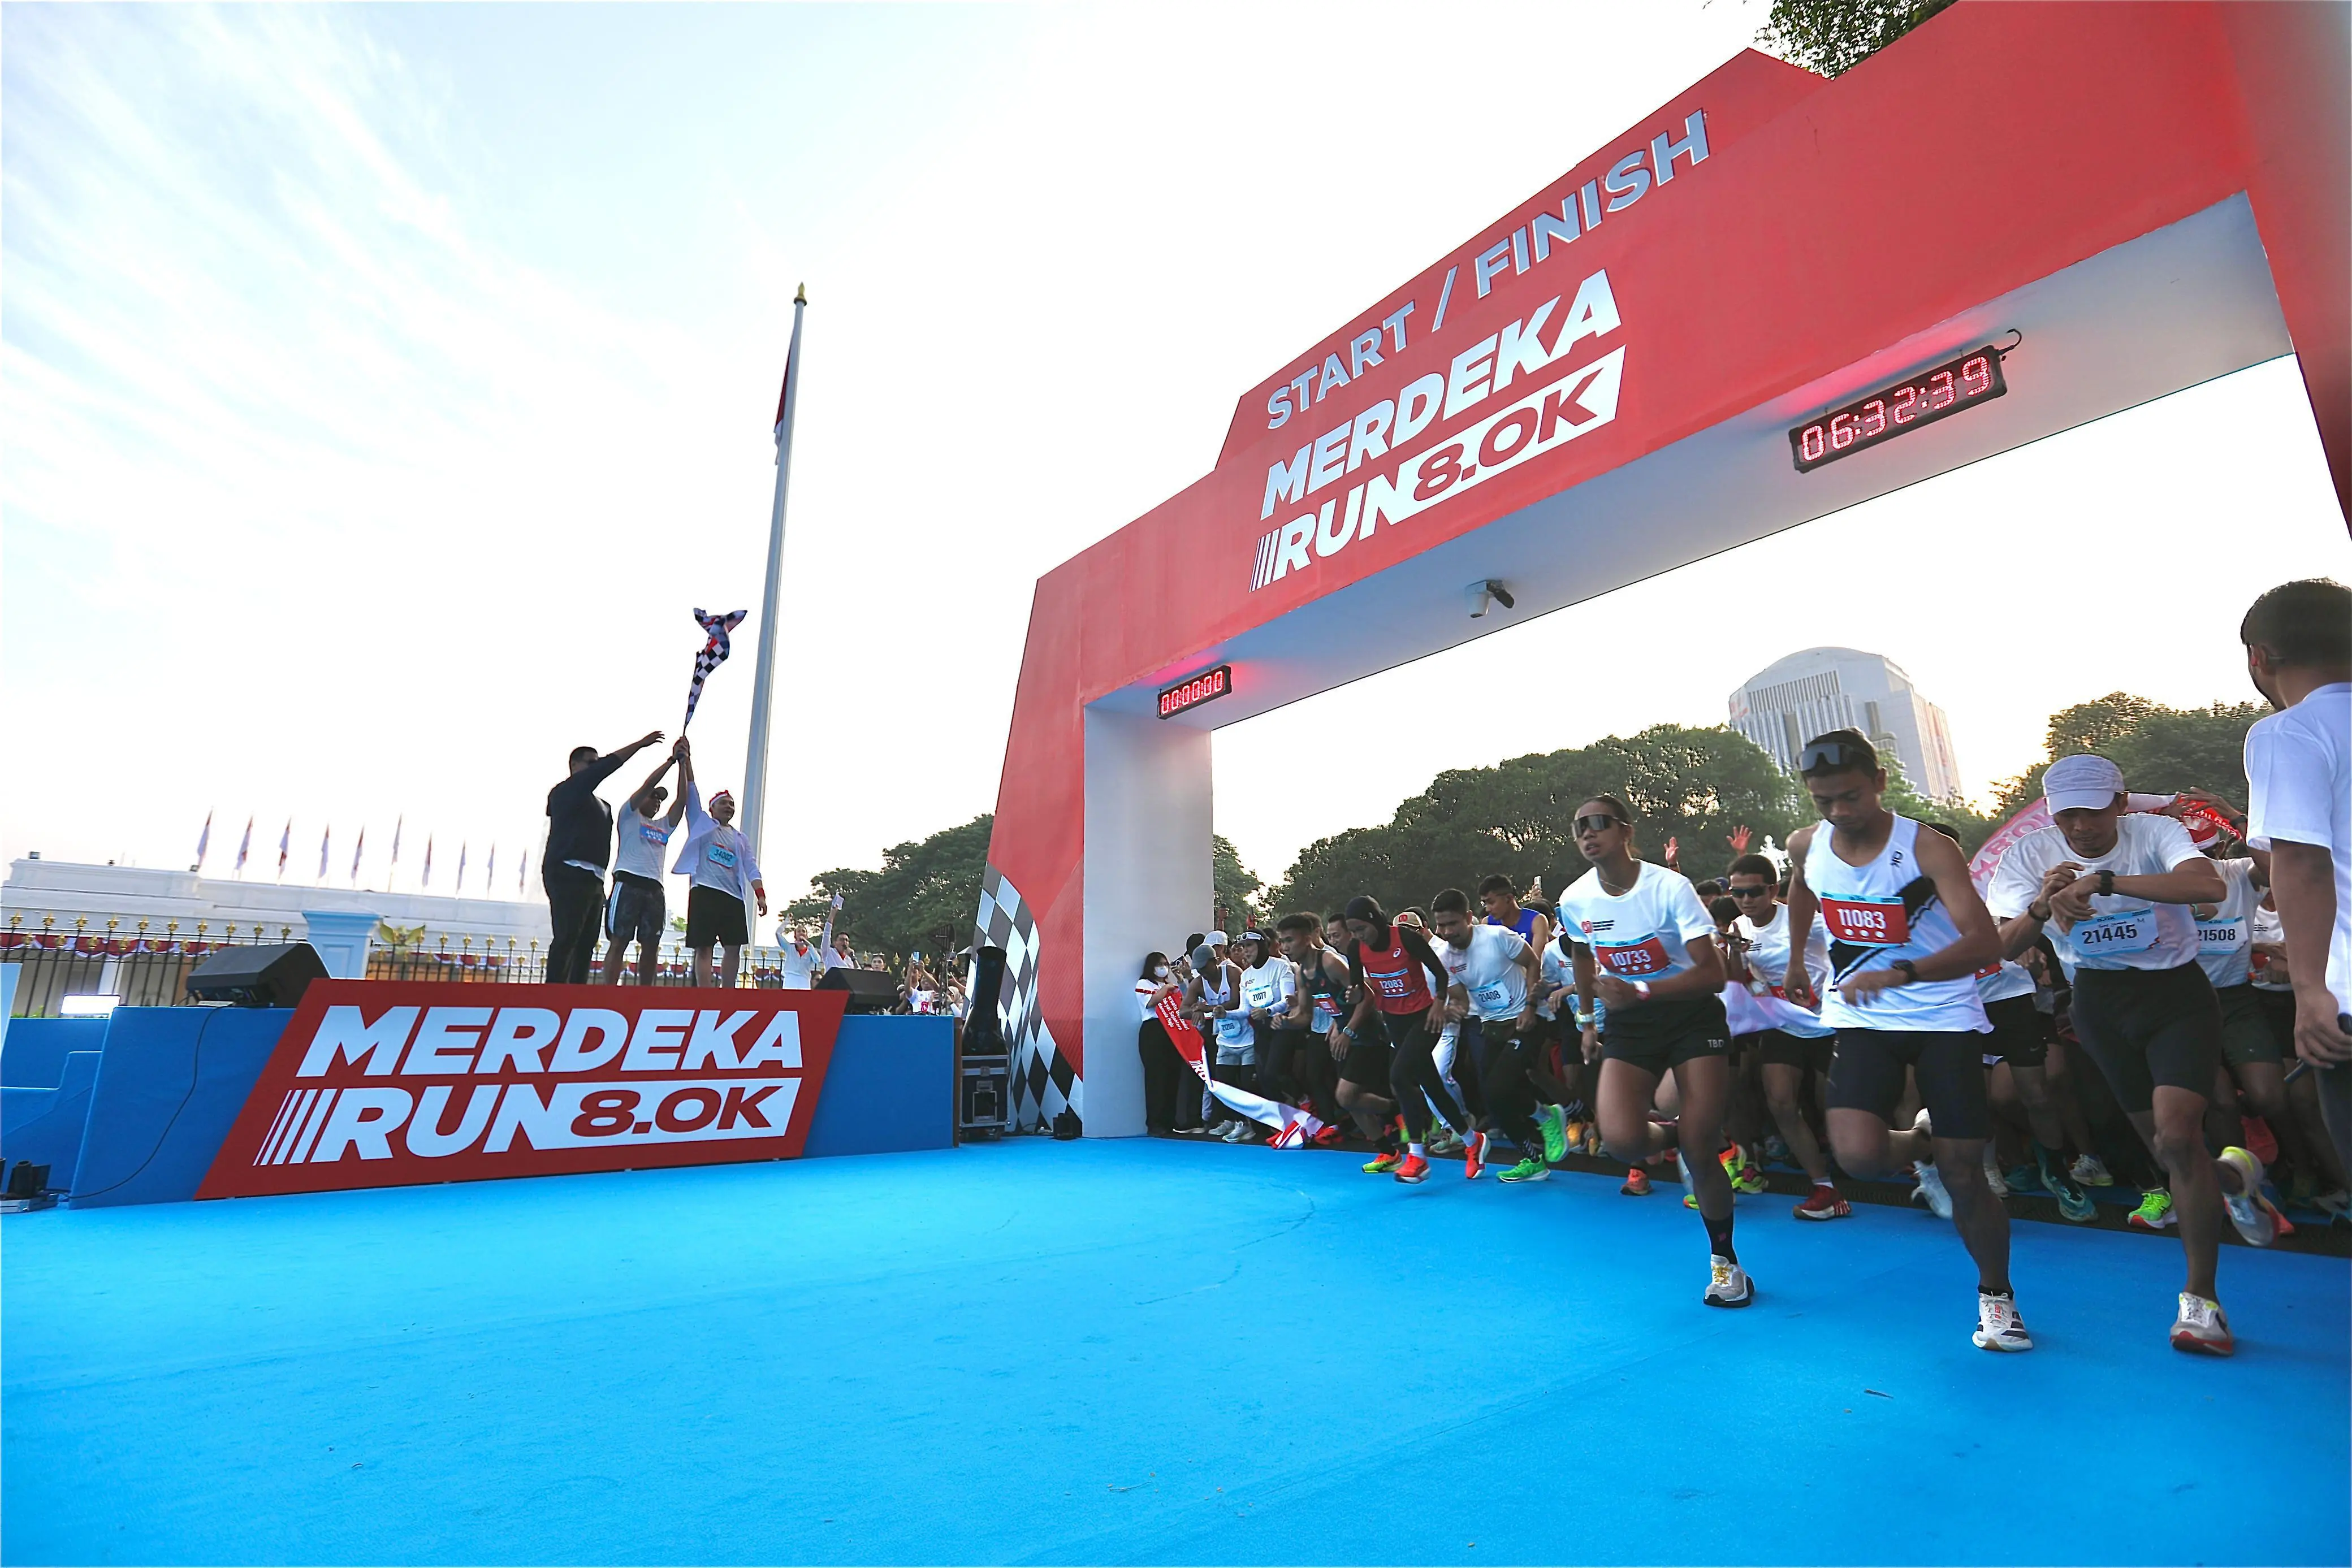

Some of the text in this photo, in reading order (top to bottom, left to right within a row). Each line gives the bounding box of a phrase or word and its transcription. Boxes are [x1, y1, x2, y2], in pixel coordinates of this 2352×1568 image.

[1267, 300, 1415, 430] START
[1475, 107, 1710, 300] FINISH
[1260, 268, 1622, 521] MERDEKA
[1801, 356, 1991, 461] 06:32:39
[1273, 455, 1416, 582] RUN
[1161, 670, 1223, 714] 00:00:00
[1836, 908, 1887, 930] 11083
[2081, 924, 2138, 945] 21445
[1607, 949, 1651, 967] 10733
[1253, 991, 1266, 1002] 21077
[1379, 978, 1404, 990] 12083
[1478, 990, 1501, 1002] 21408
[295, 1005, 803, 1077] MERDEKA
[1707, 1039, 1724, 1048] TBD
[310, 1079, 568, 1162] RUN
